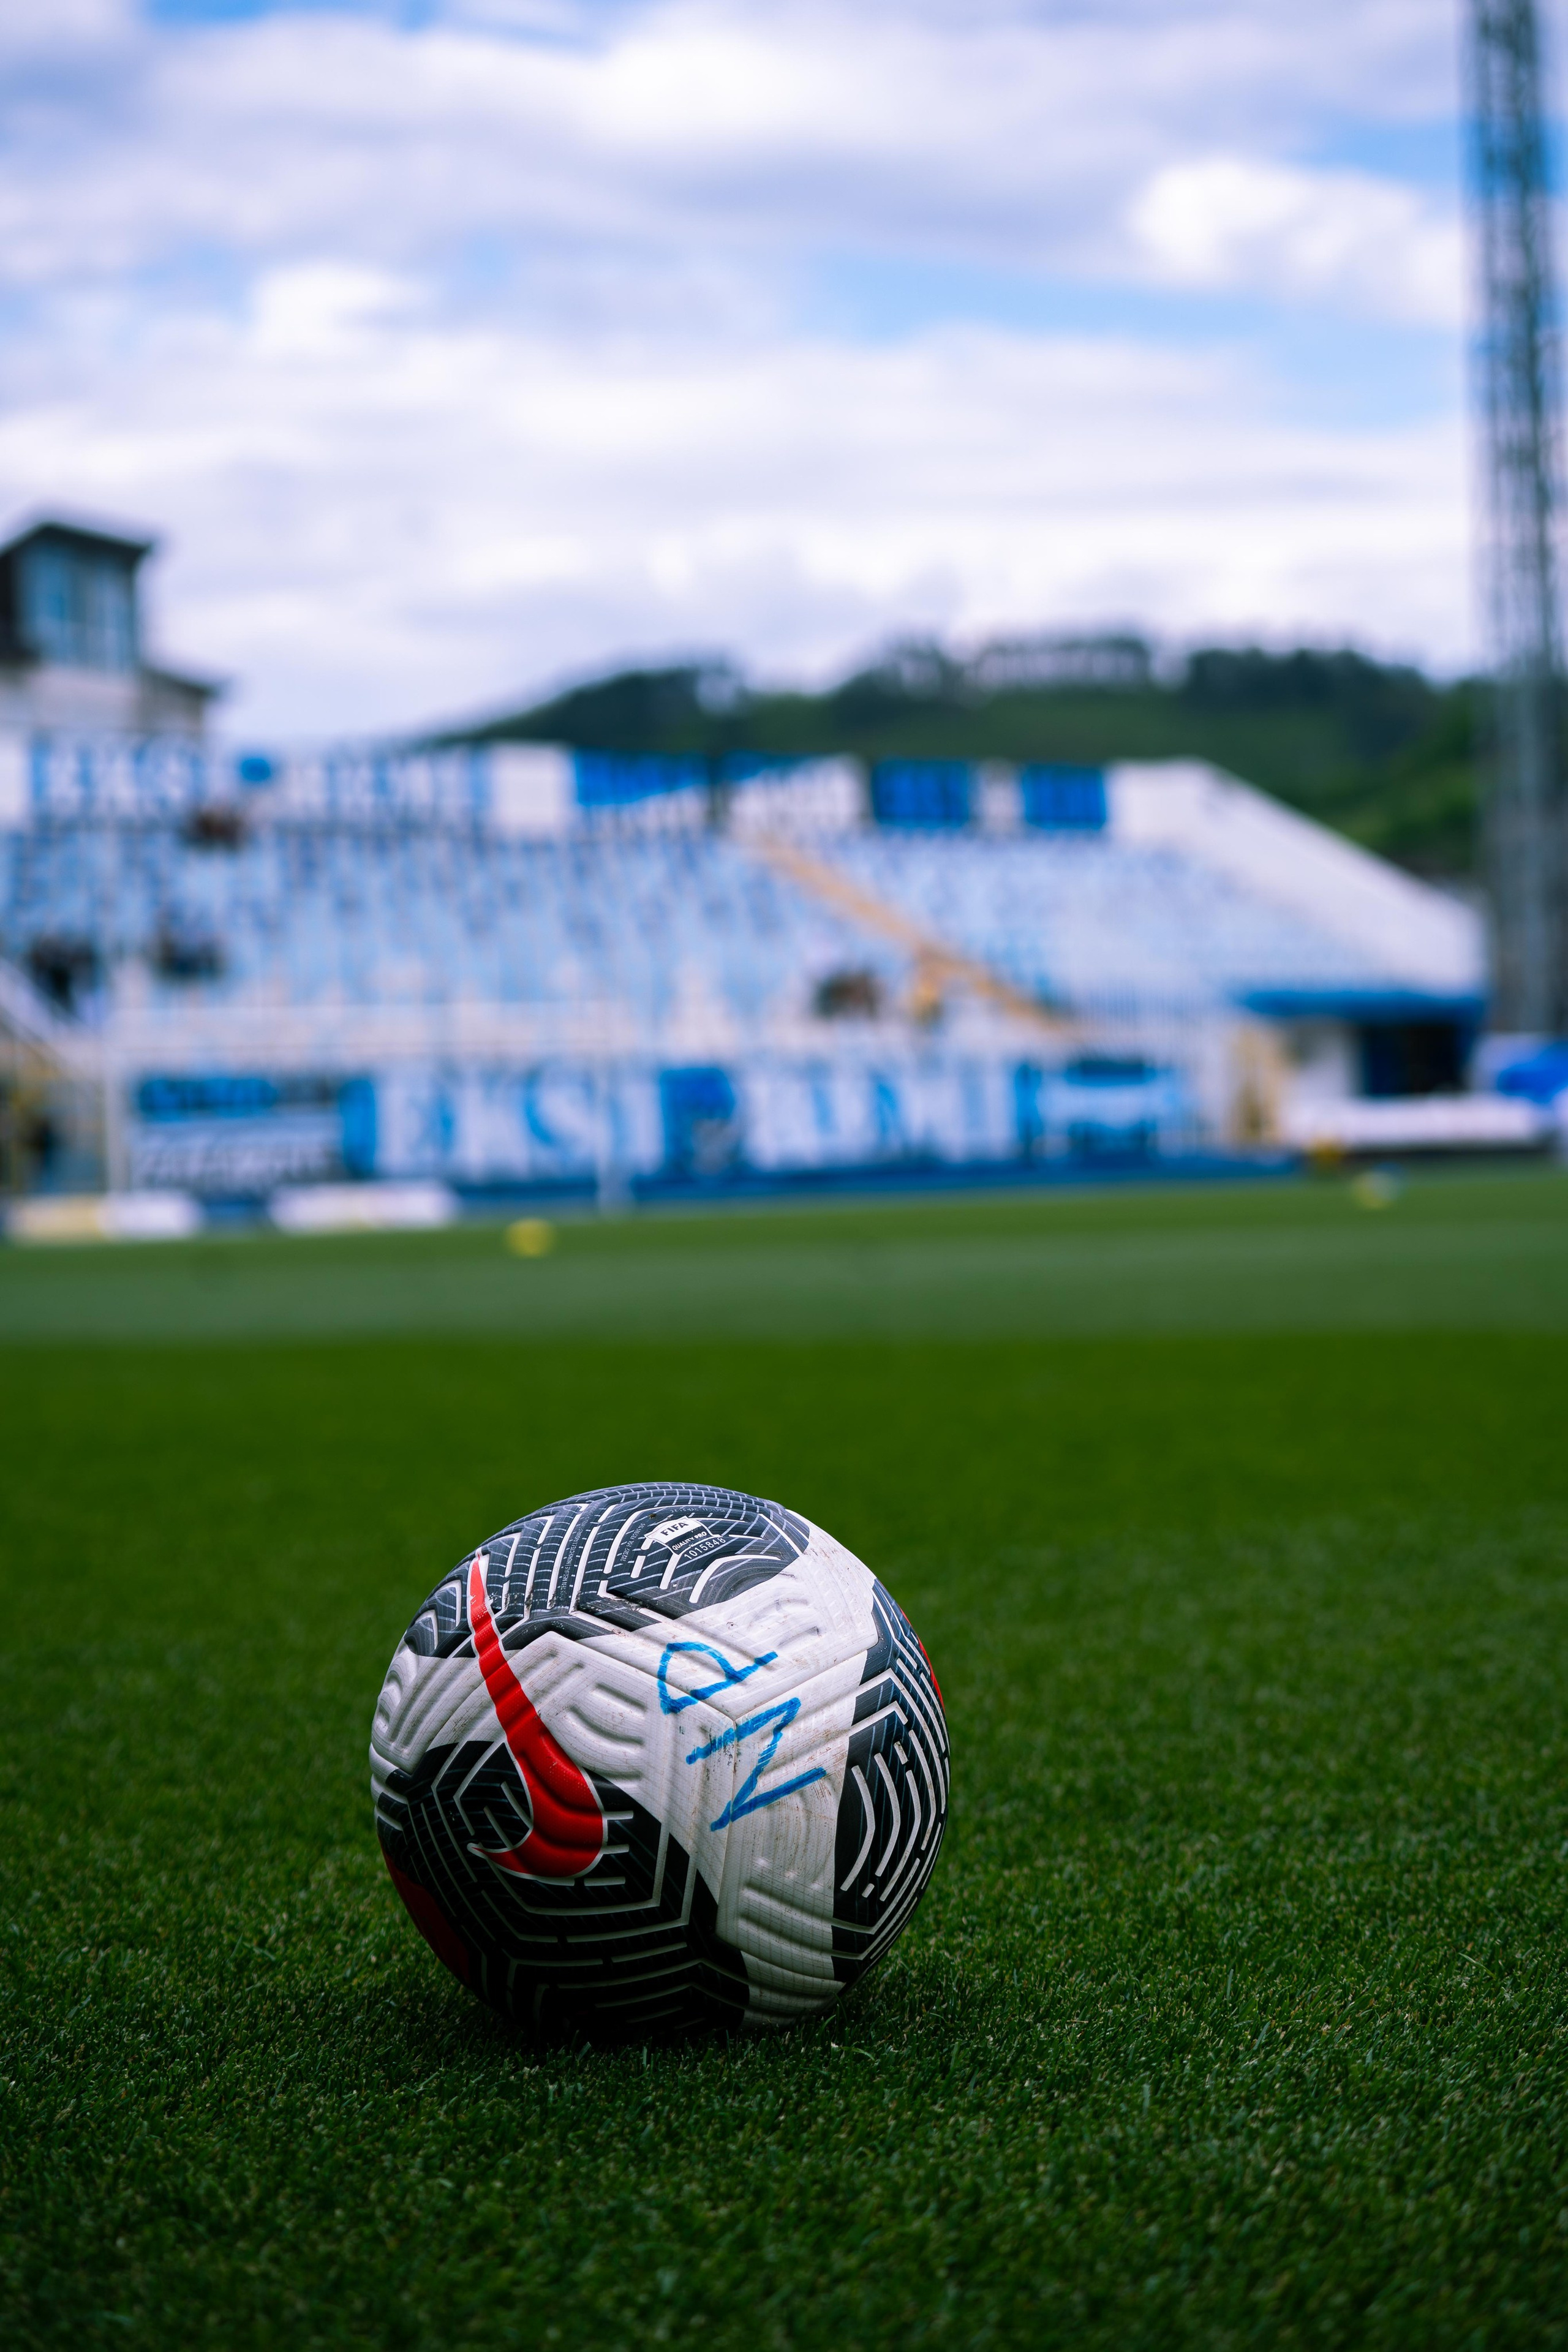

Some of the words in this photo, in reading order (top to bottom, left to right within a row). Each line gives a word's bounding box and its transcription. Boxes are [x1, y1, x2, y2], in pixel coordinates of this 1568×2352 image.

[660, 1521, 688, 1536] FIFA
[672, 1537, 694, 1550] QUALITY
[684, 1537, 726, 1559] 1015848
